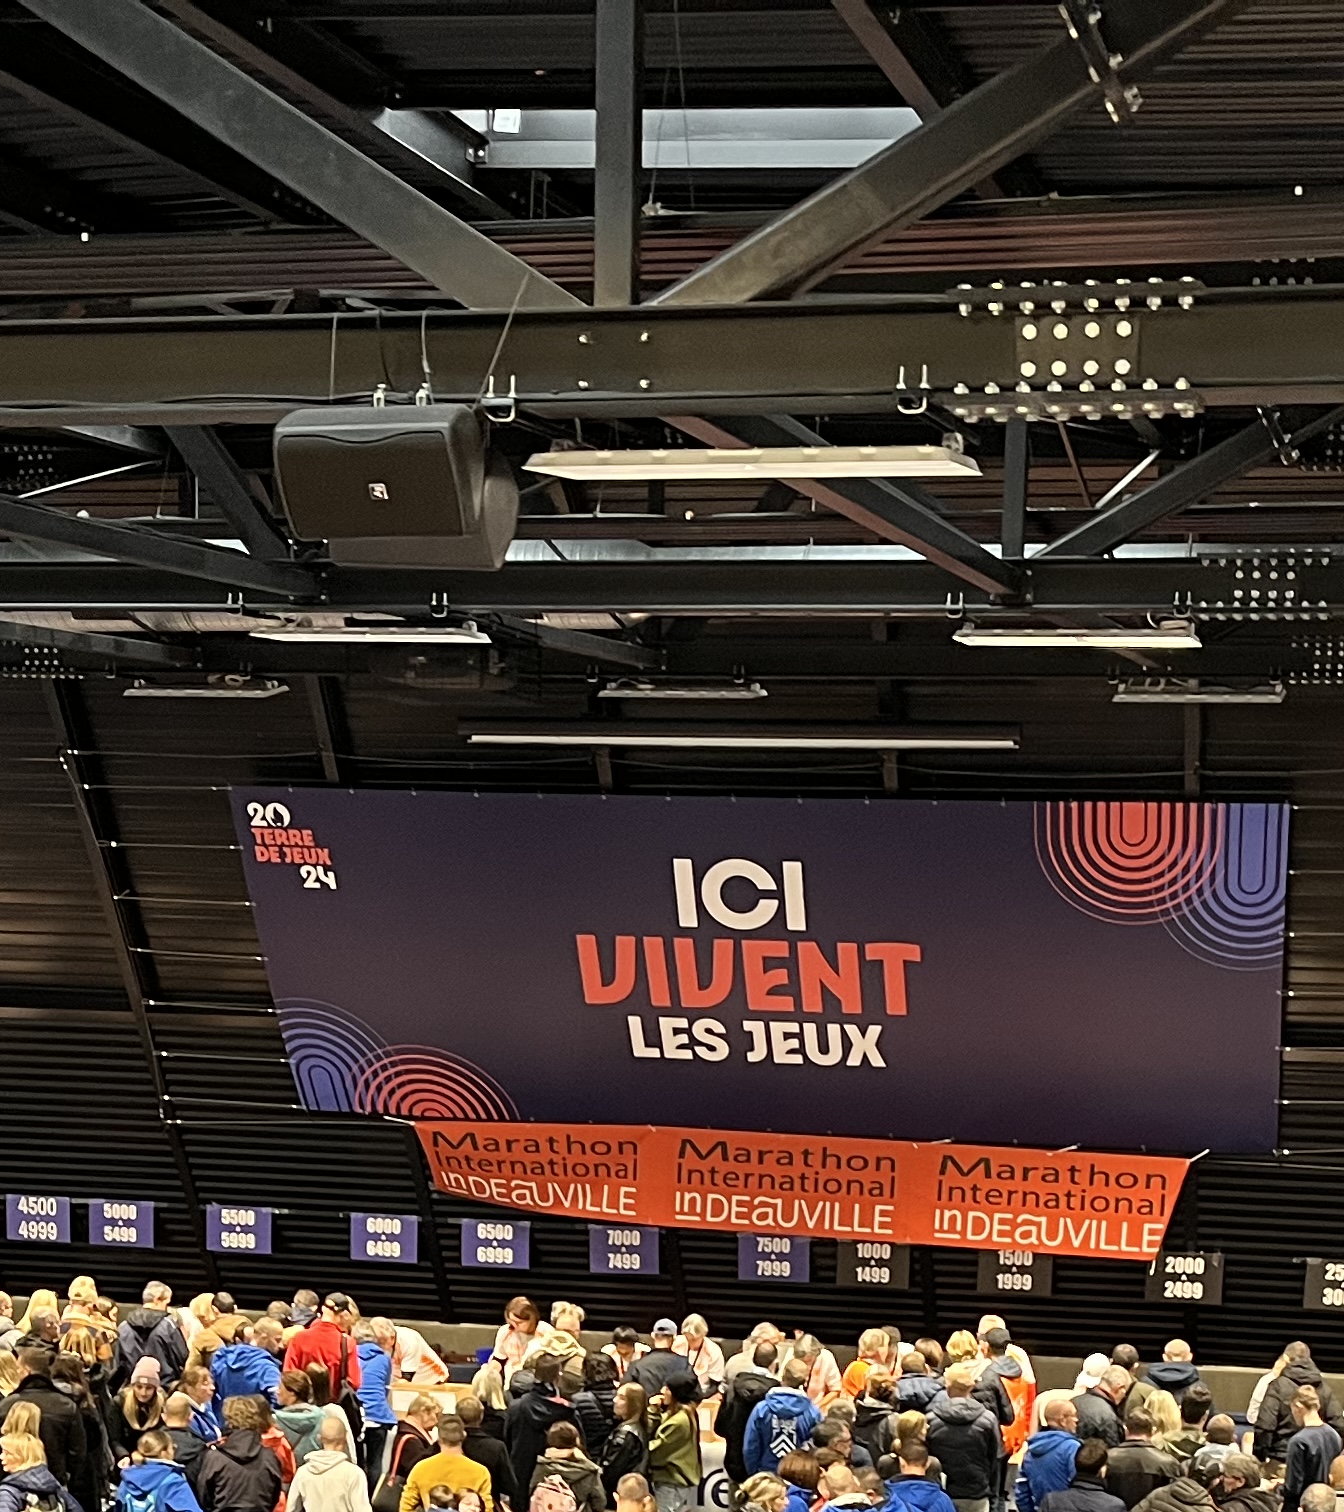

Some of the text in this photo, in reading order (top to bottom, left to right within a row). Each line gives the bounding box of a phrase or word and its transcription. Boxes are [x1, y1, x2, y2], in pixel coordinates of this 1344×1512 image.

[247, 802, 291, 827] 20
[251, 828, 315, 846] TERRE
[255, 845, 332, 865] DE JEUX
[300, 865, 337, 890] 24
[673, 858, 806, 931] ICI
[576, 934, 921, 1015] VIVENT
[627, 1015, 887, 1068] LES JEUX
[432, 1131, 638, 1156] Marathon
[678, 1139, 896, 1173] Marathon
[434, 1150, 638, 1181] International
[939, 1155, 1168, 1191] Marathon
[677, 1162, 895, 1199] International
[18, 1196, 56, 1216] 4500
[937, 1179, 1166, 1217] International
[103, 1203, 137, 1220] 5000
[221, 1208, 255, 1226] 5500
[18, 1220, 57, 1240] 4999
[103, 1225, 137, 1242] 5499
[366, 1217, 402, 1235] 6000
[477, 1223, 513, 1240] 6500
[221, 1231, 255, 1249] 5999
[607, 1229, 641, 1246] 7000
[756, 1237, 791, 1254] 7500
[366, 1240, 401, 1258] 6499
[476, 1246, 514, 1264] 6999
[857, 1243, 891, 1260] 1000
[607, 1253, 641, 1270] 7499
[997, 1250, 1033, 1267] 1500
[1165, 1256, 1205, 1275] 2000
[756, 1260, 791, 1277] 7999
[856, 1267, 890, 1283] 1499
[996, 1273, 1032, 1291] 1999
[1164, 1281, 1203, 1299] 2499
